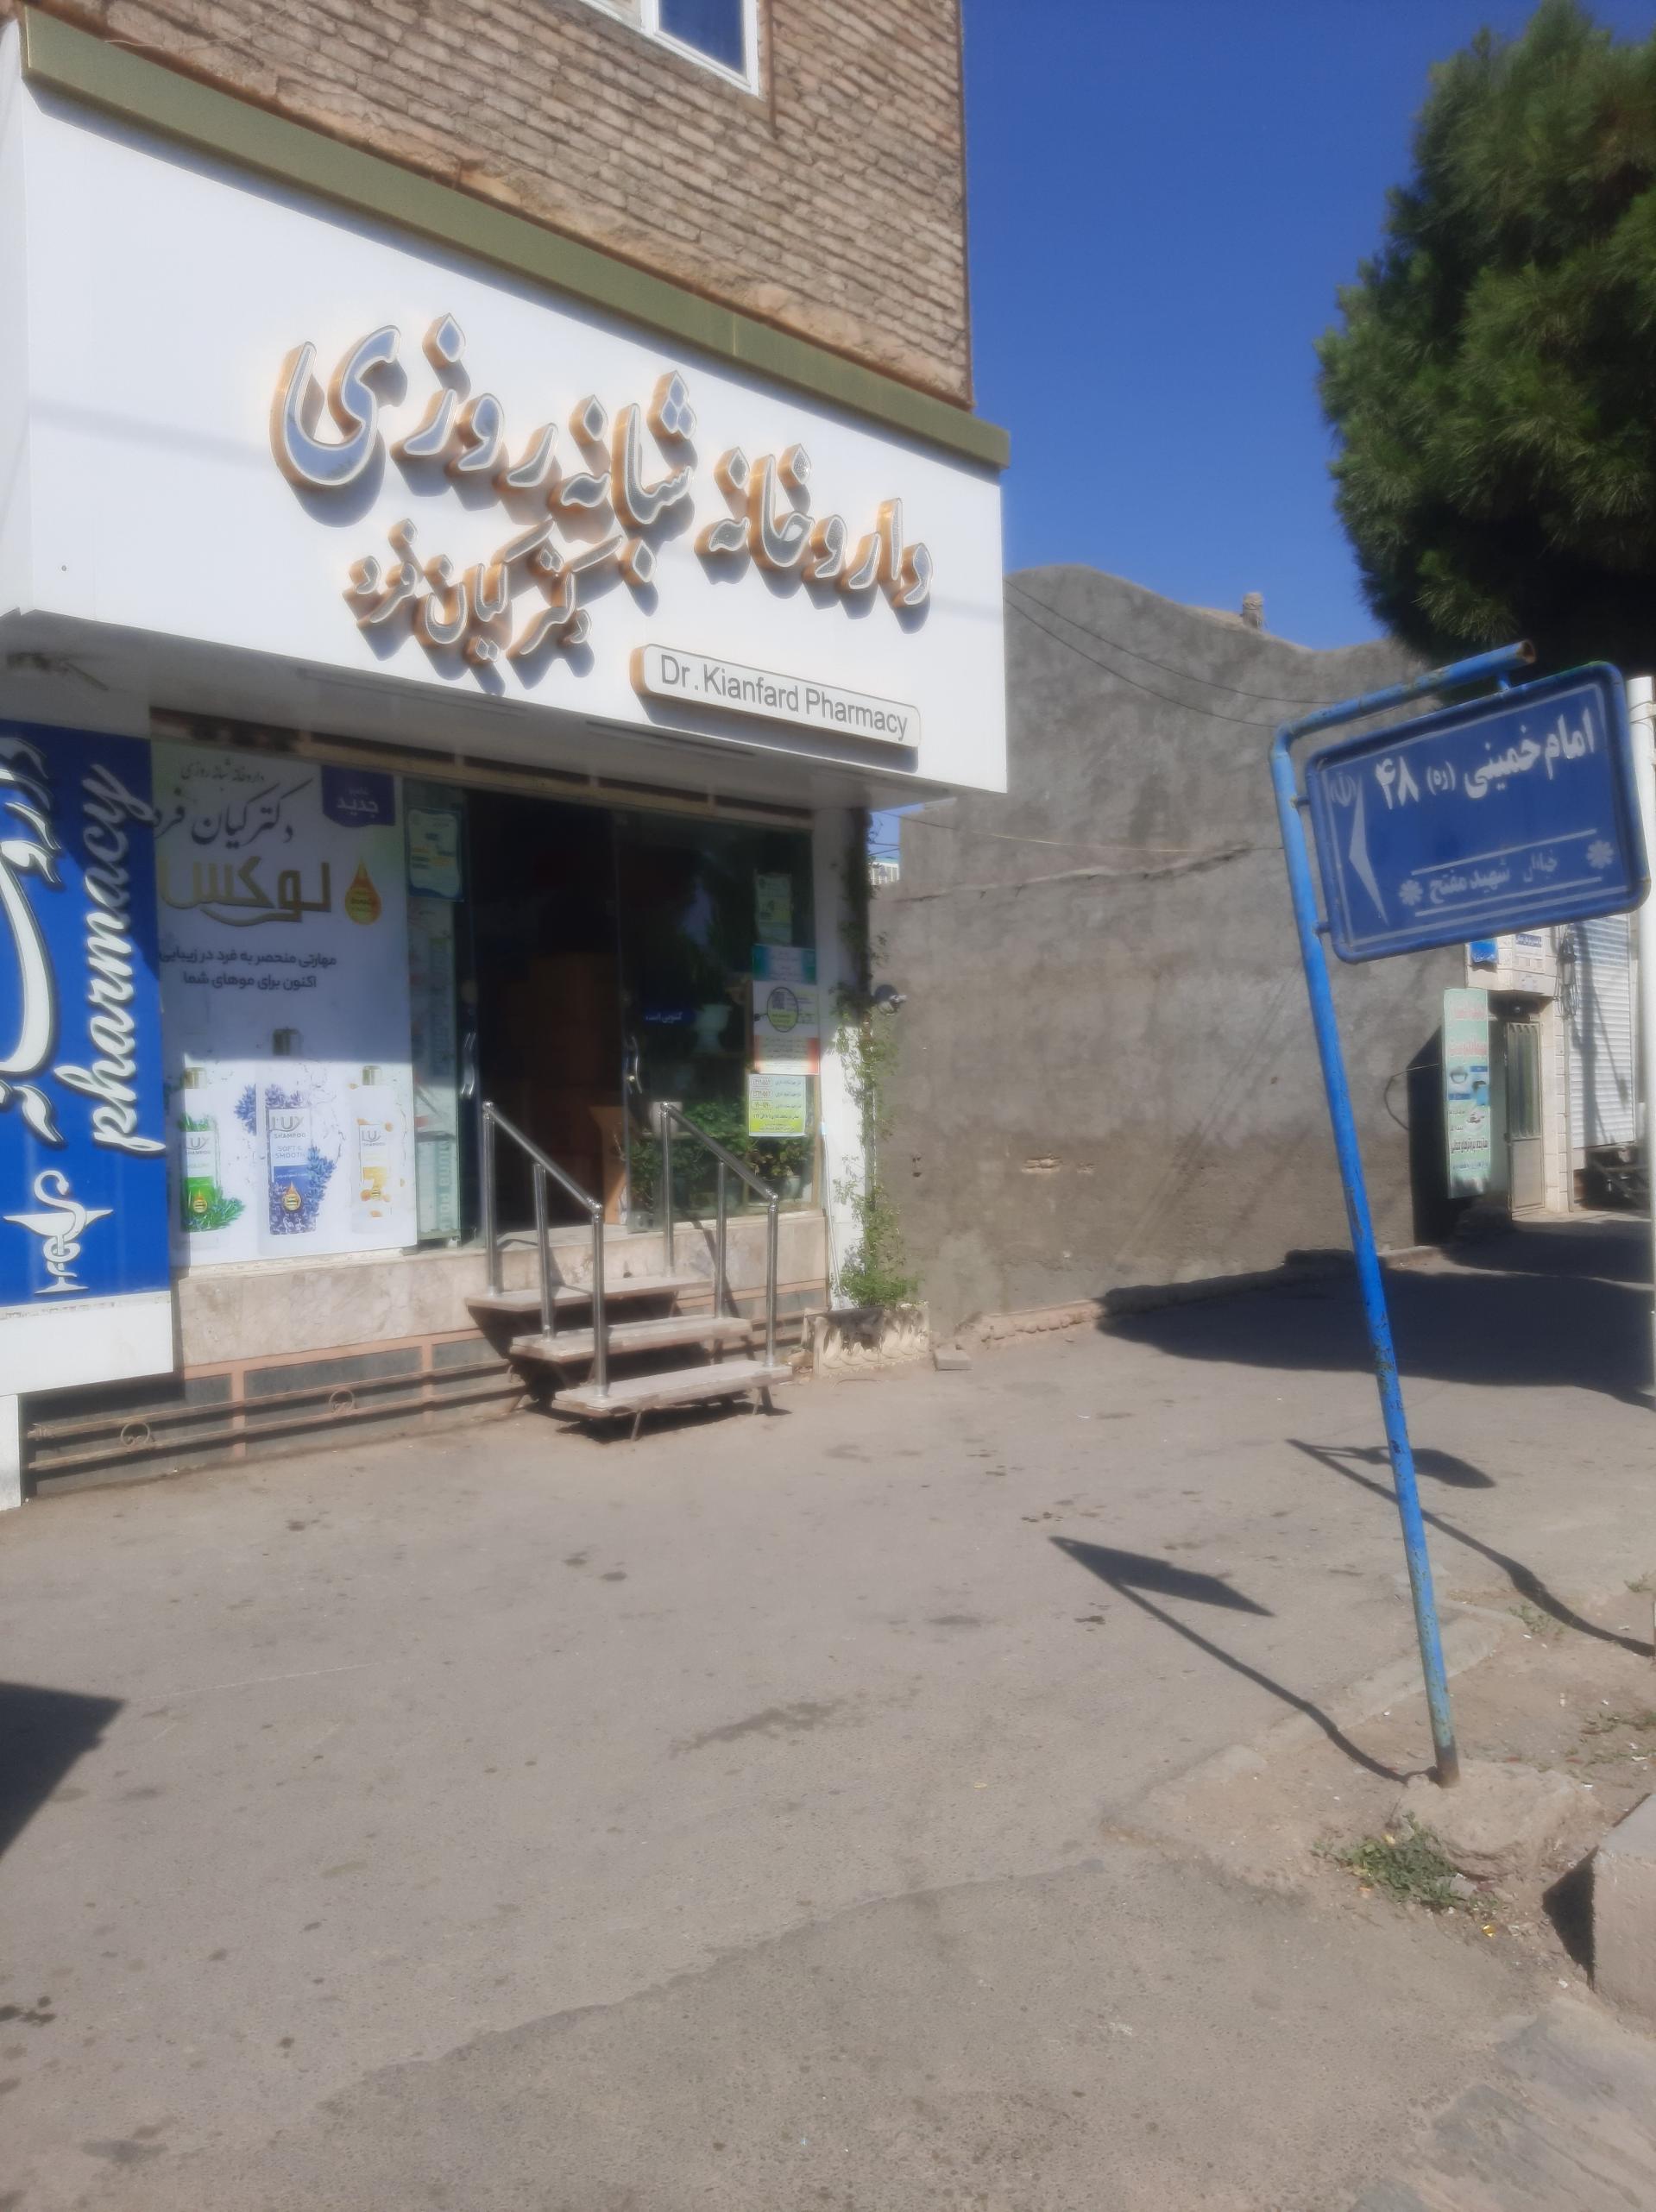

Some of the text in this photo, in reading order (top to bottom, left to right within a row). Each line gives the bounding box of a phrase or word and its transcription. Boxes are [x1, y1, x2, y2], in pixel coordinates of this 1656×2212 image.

[271, 313, 934, 607] داروخانه شبانه روزی
[507, 534, 623, 656] دکتر
[703, 663, 799, 713] Kianfard
[805, 688, 909, 741] Pharmacy
[1464, 725, 1541, 799] خمینی
[1545, 707, 1595, 780] امام
[239, 777, 313, 847] دکتر
[1376, 755, 1420, 810] ۴۸
[156, 855, 331, 927] لوکس
[182, 971, 318, 991] اکنون برای موهای شما
[199, 949, 214, 964] در
[217, 948, 238, 963] فرد
[240, 951, 254, 963] به
[255, 950, 296, 966] منحصر
[298, 952, 337, 969] مهارتی
